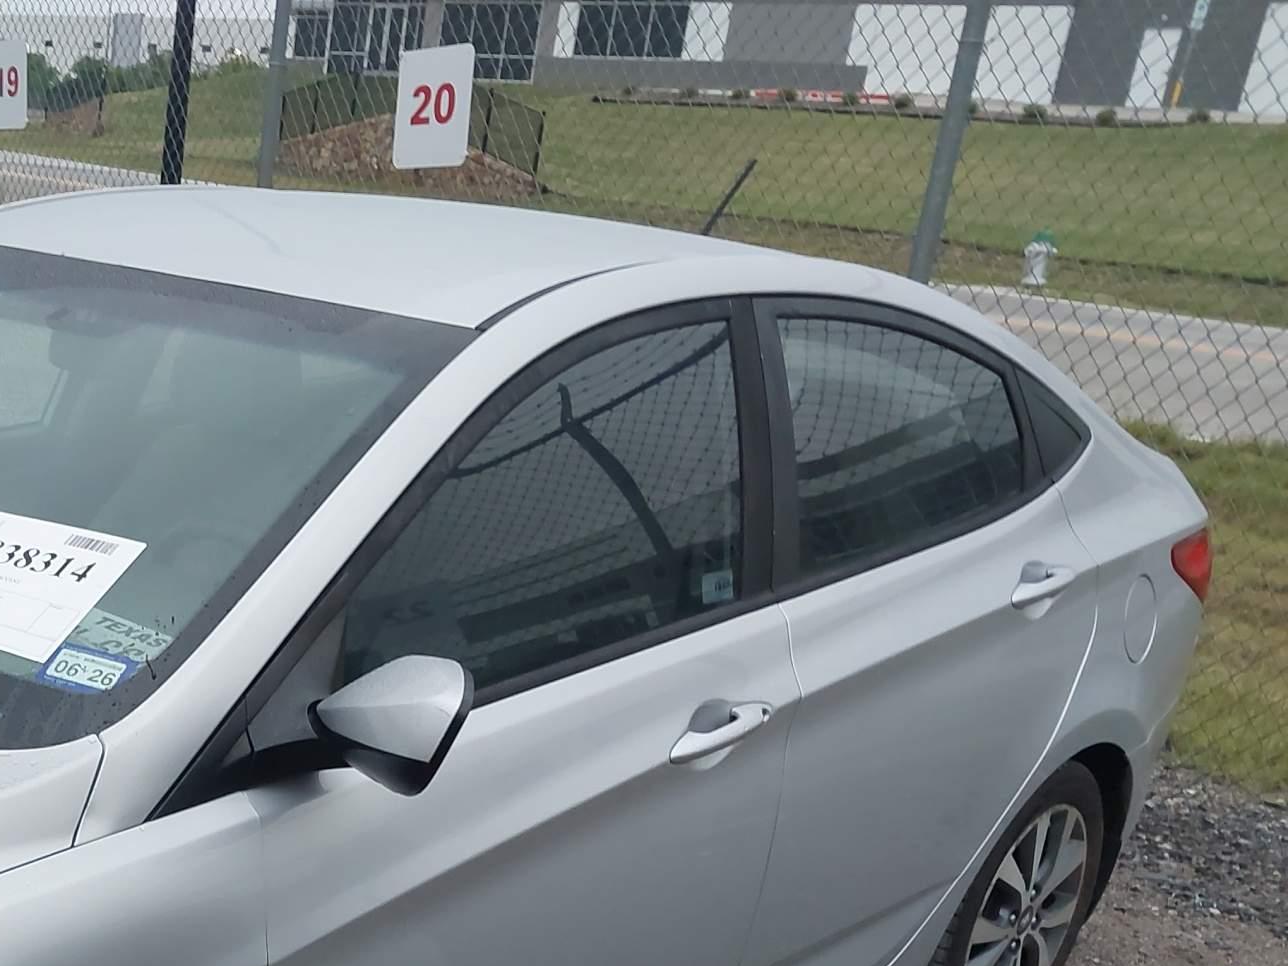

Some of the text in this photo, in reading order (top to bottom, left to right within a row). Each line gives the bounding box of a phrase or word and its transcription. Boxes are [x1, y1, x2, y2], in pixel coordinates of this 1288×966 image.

[410, 81, 456, 126] 20
[95, 616, 168, 648] TEXAS
[54, 659, 81, 677] 06
[87, 668, 117, 686] 26
